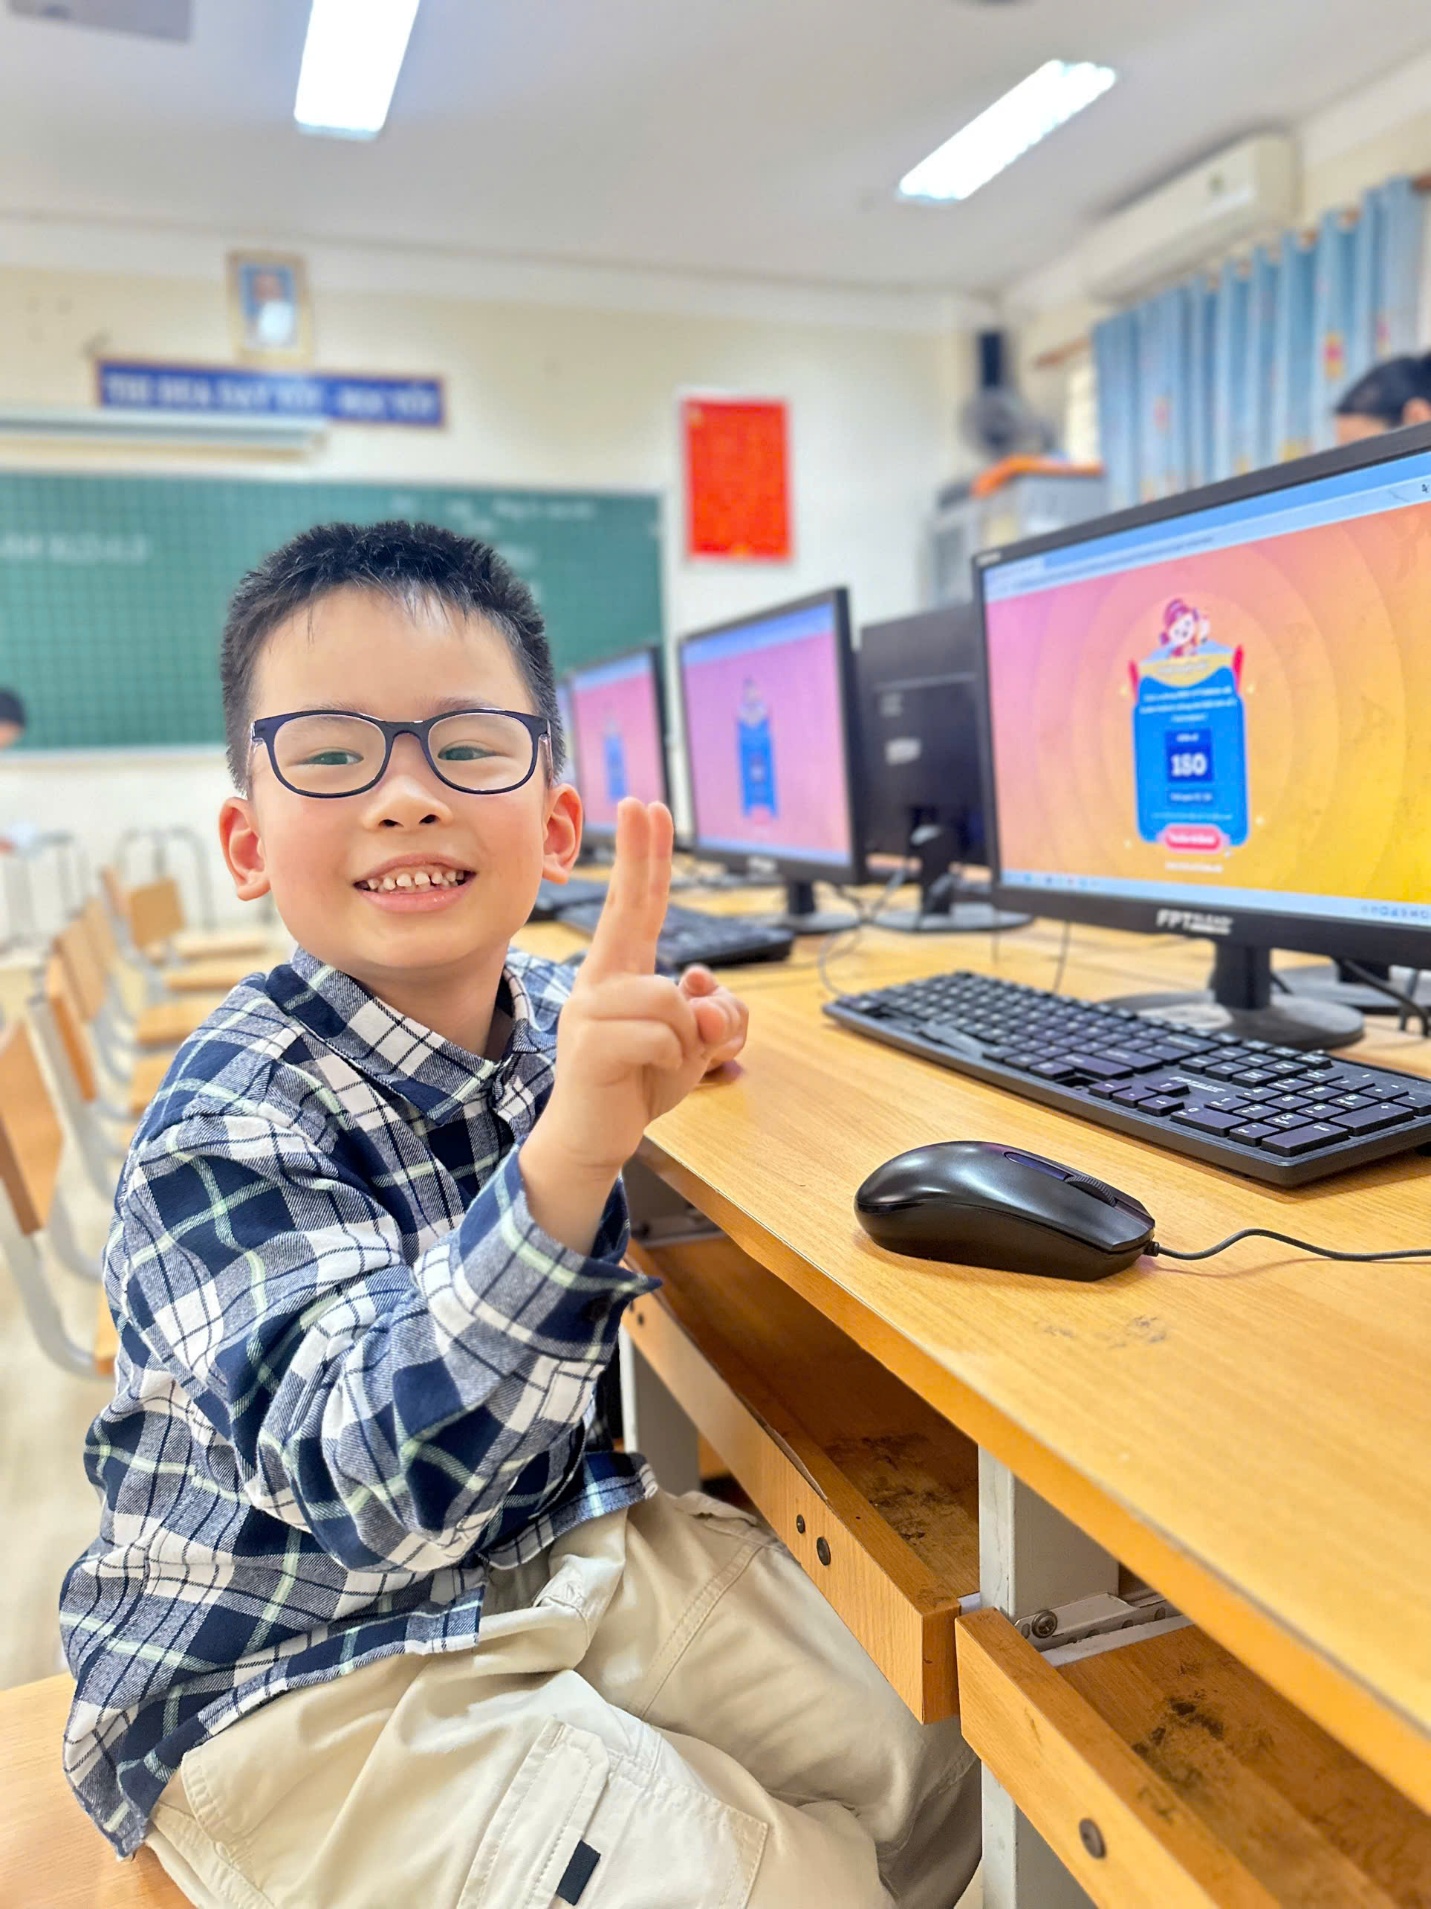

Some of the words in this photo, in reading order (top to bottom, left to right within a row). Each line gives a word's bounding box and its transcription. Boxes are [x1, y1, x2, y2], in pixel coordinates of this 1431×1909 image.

[1156, 908, 1192, 931] FPT
[1344, 1093, 1359, 1101] 9
[1281, 1113, 1295, 1121] 3
